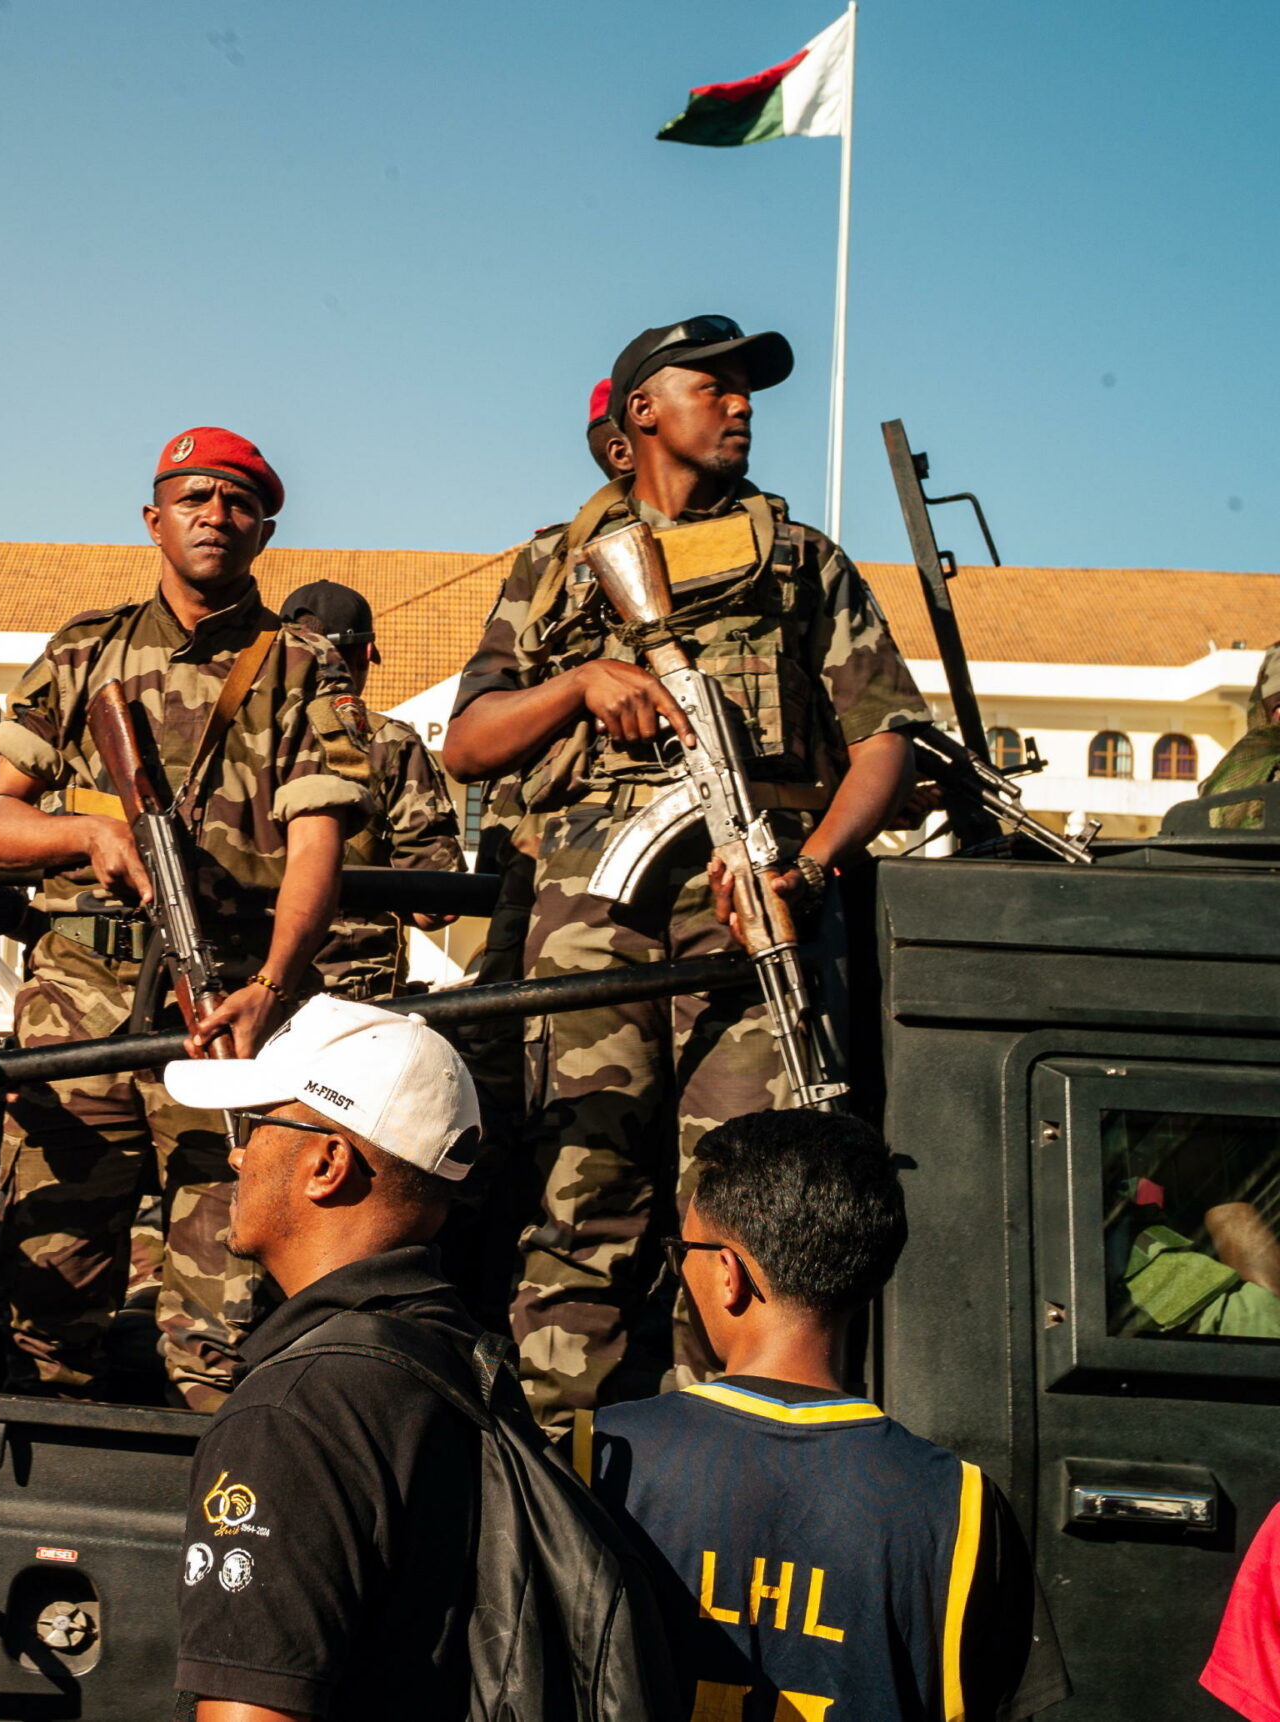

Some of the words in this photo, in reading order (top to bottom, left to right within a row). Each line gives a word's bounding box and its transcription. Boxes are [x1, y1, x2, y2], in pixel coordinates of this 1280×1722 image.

[303, 1080, 356, 1111] M-FIRST
[40, 1549, 74, 1560] DIESEL
[699, 1550, 845, 1643] LHL
